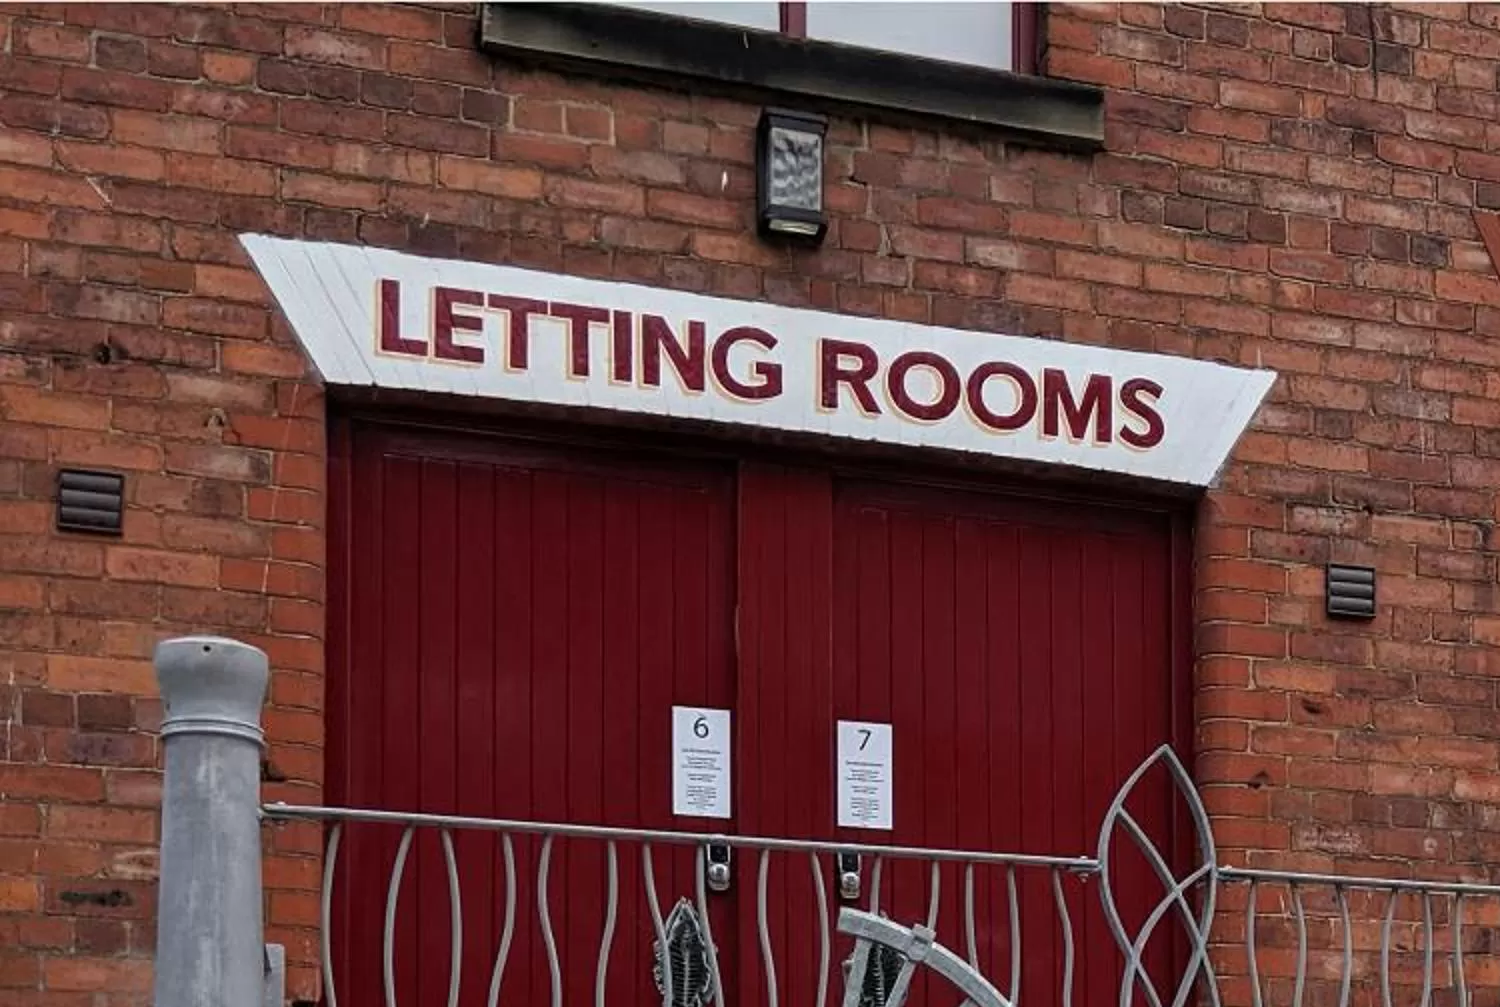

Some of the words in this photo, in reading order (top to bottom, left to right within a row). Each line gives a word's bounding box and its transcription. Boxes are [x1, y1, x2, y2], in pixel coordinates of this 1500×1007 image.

[378, 279, 784, 401] LETTING
[818, 337, 1165, 449] ROOMS
[693, 716, 709, 738] 6
[857, 728, 872, 751] 7
